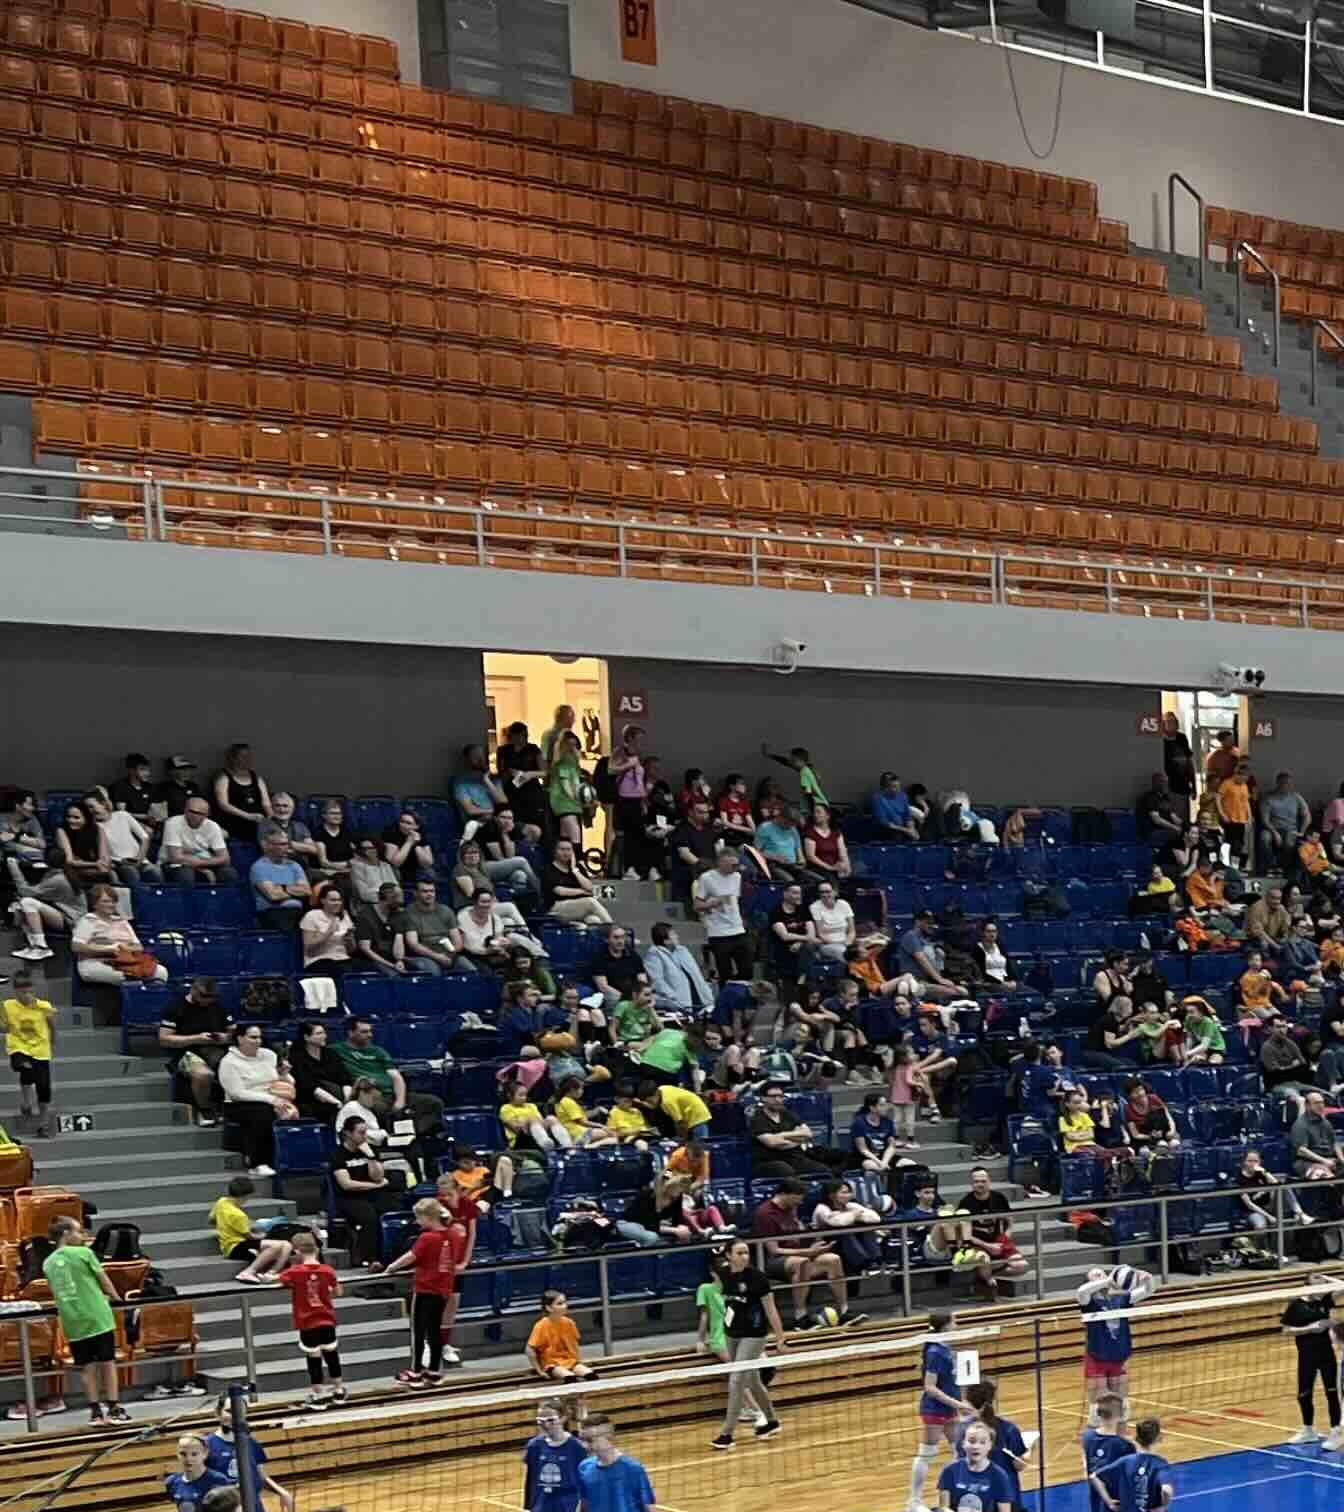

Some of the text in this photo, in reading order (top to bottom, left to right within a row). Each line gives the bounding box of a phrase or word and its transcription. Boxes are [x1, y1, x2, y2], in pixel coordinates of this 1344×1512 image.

[623, 0, 649, 40] B7
[619, 695, 643, 712] A5
[1140, 717, 1160, 732] A5
[1255, 722, 1273, 737] A6
